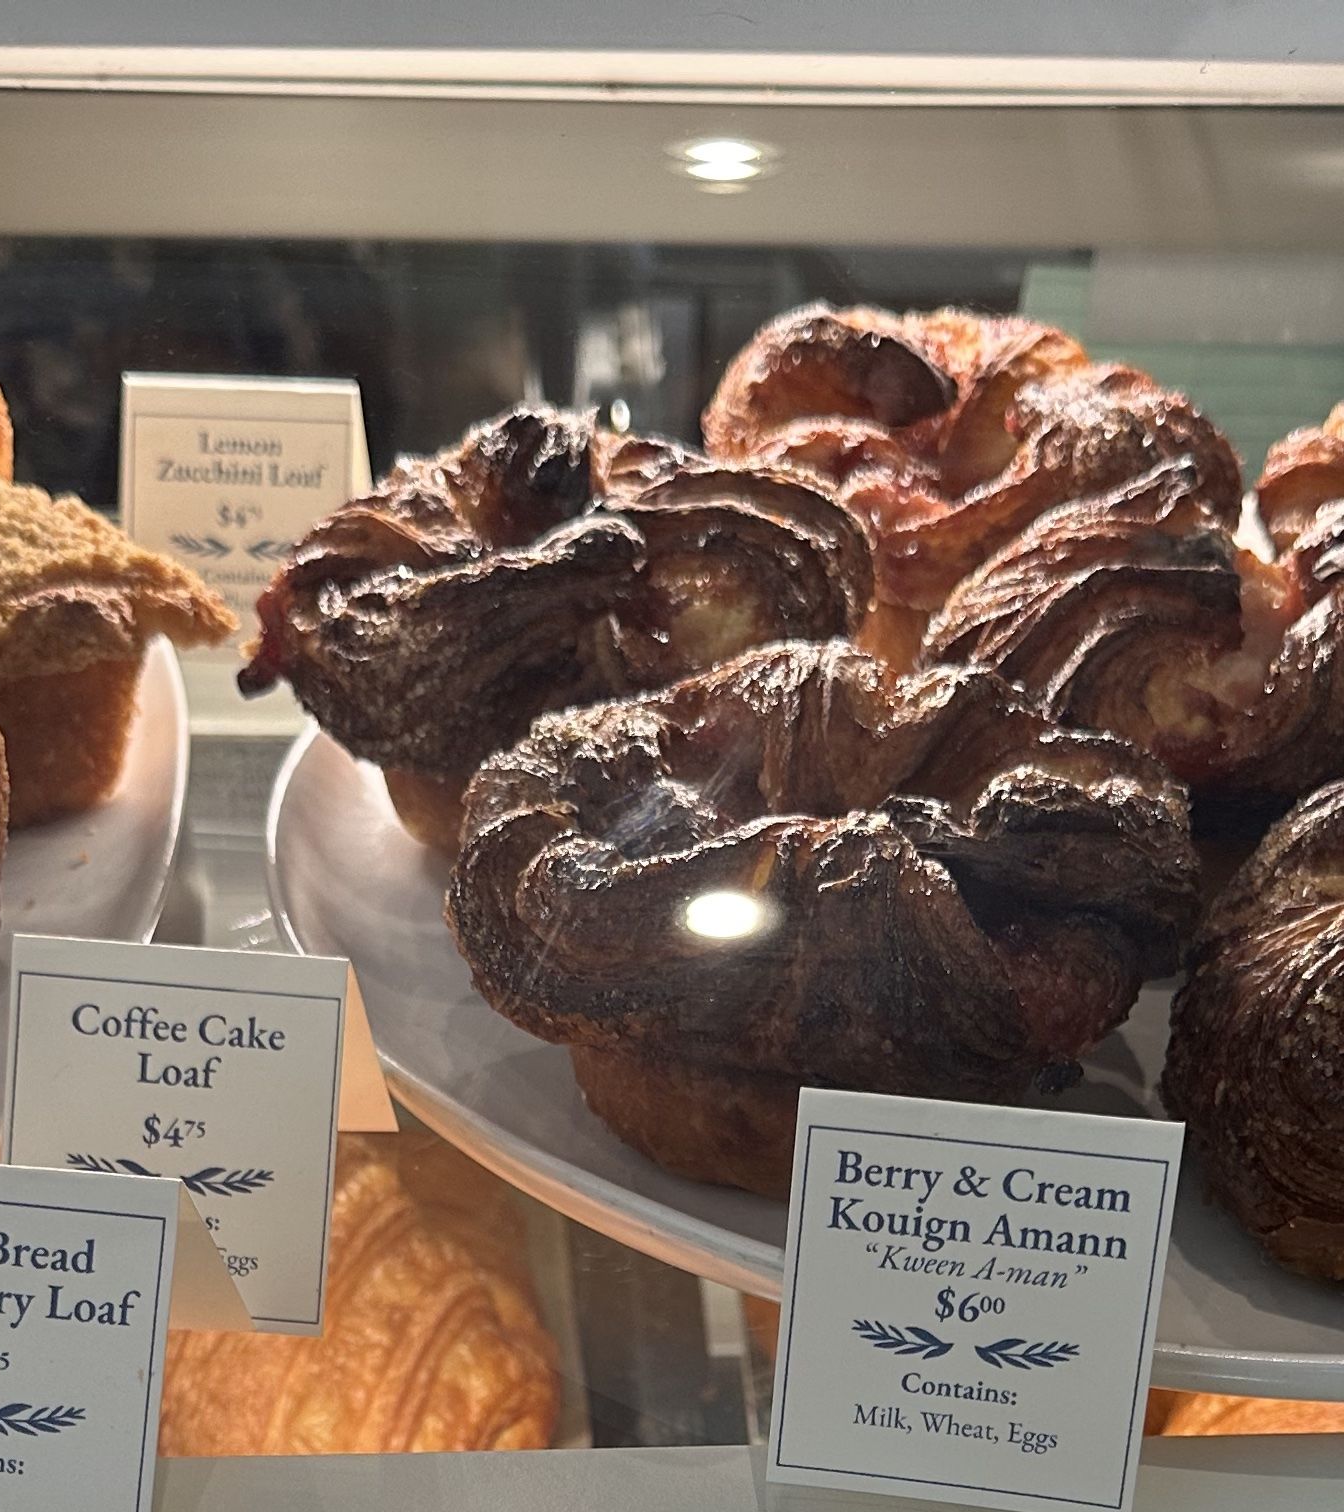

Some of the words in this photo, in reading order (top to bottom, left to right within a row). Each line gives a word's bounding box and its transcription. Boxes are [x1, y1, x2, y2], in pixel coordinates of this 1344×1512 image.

[198, 432, 283, 456] Lemon
[157, 459, 262, 486] Zucchini
[269, 463, 327, 488] Loaf
[71, 1003, 188, 1043] Coffee
[198, 1014, 286, 1051] Cake
[137, 1051, 223, 1089] Loaf
[834, 1149, 944, 1205] Berry
[952, 1165, 991, 1198] &
[1002, 1168, 1131, 1213] Cream
[826, 1196, 971, 1254] Kouign
[981, 1213, 1128, 1260] Amann
[44, 1284, 142, 1327] Loaf
[901, 1372, 1017, 1406] Contains:
[852, 1403, 913, 1434] Milk,
[919, 1411, 999, 1445] Wheat,
[1007, 1421, 1058, 1455] Eggs
